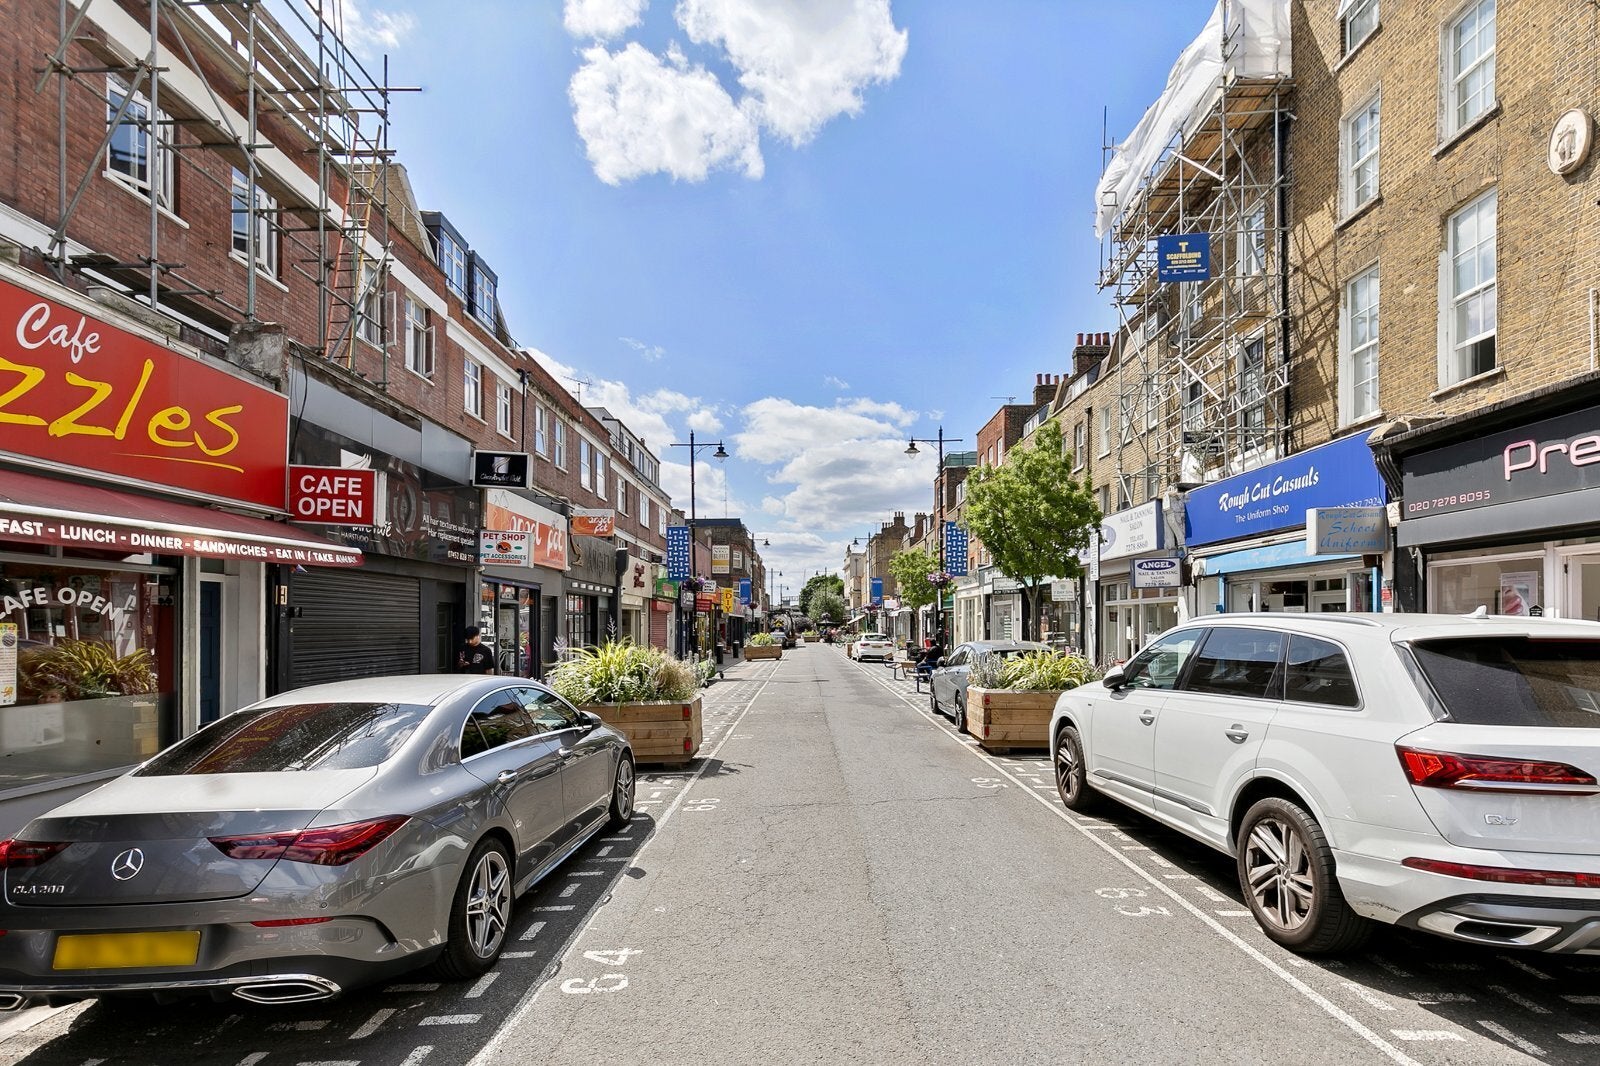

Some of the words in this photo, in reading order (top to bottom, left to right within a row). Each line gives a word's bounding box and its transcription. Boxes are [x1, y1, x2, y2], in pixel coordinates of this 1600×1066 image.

[16, 302, 100, 364] Cafe
[300, 474, 362, 496] CAFE
[1218, 486, 1250, 512] Rough
[1251, 482, 1270, 502] Cut
[1272, 466, 1320, 496] Casuals
[298, 497, 363, 518] OPEN
[1408, 501, 1430, 512] 020
[1432, 496, 1457, 508] 7278
[1459, 490, 1491, 504] 8095
[1236, 514, 1246, 524] The
[1247, 508, 1272, 521] Uniform
[1272, 504, 1290, 516] Shop
[440, 520, 458, 531] textures
[1328, 522, 1376, 536] School
[60, 525, 116, 543] LUNCH
[130, 533, 183, 550] DINNER
[193, 540, 268, 557] SANDWICHES
[276, 551, 292, 559] EAT
[295, 551, 304, 560] IN
[313, 552, 334, 563] TAKE
[502, 533, 526, 541] SHOP
[1320, 536, 1384, 552] Uniforms
[58, 587, 124, 621] OPEN
[13, 886, 36, 894] CLA
[39, 885, 65, 894] 200
[560, 948, 645, 996] 64
